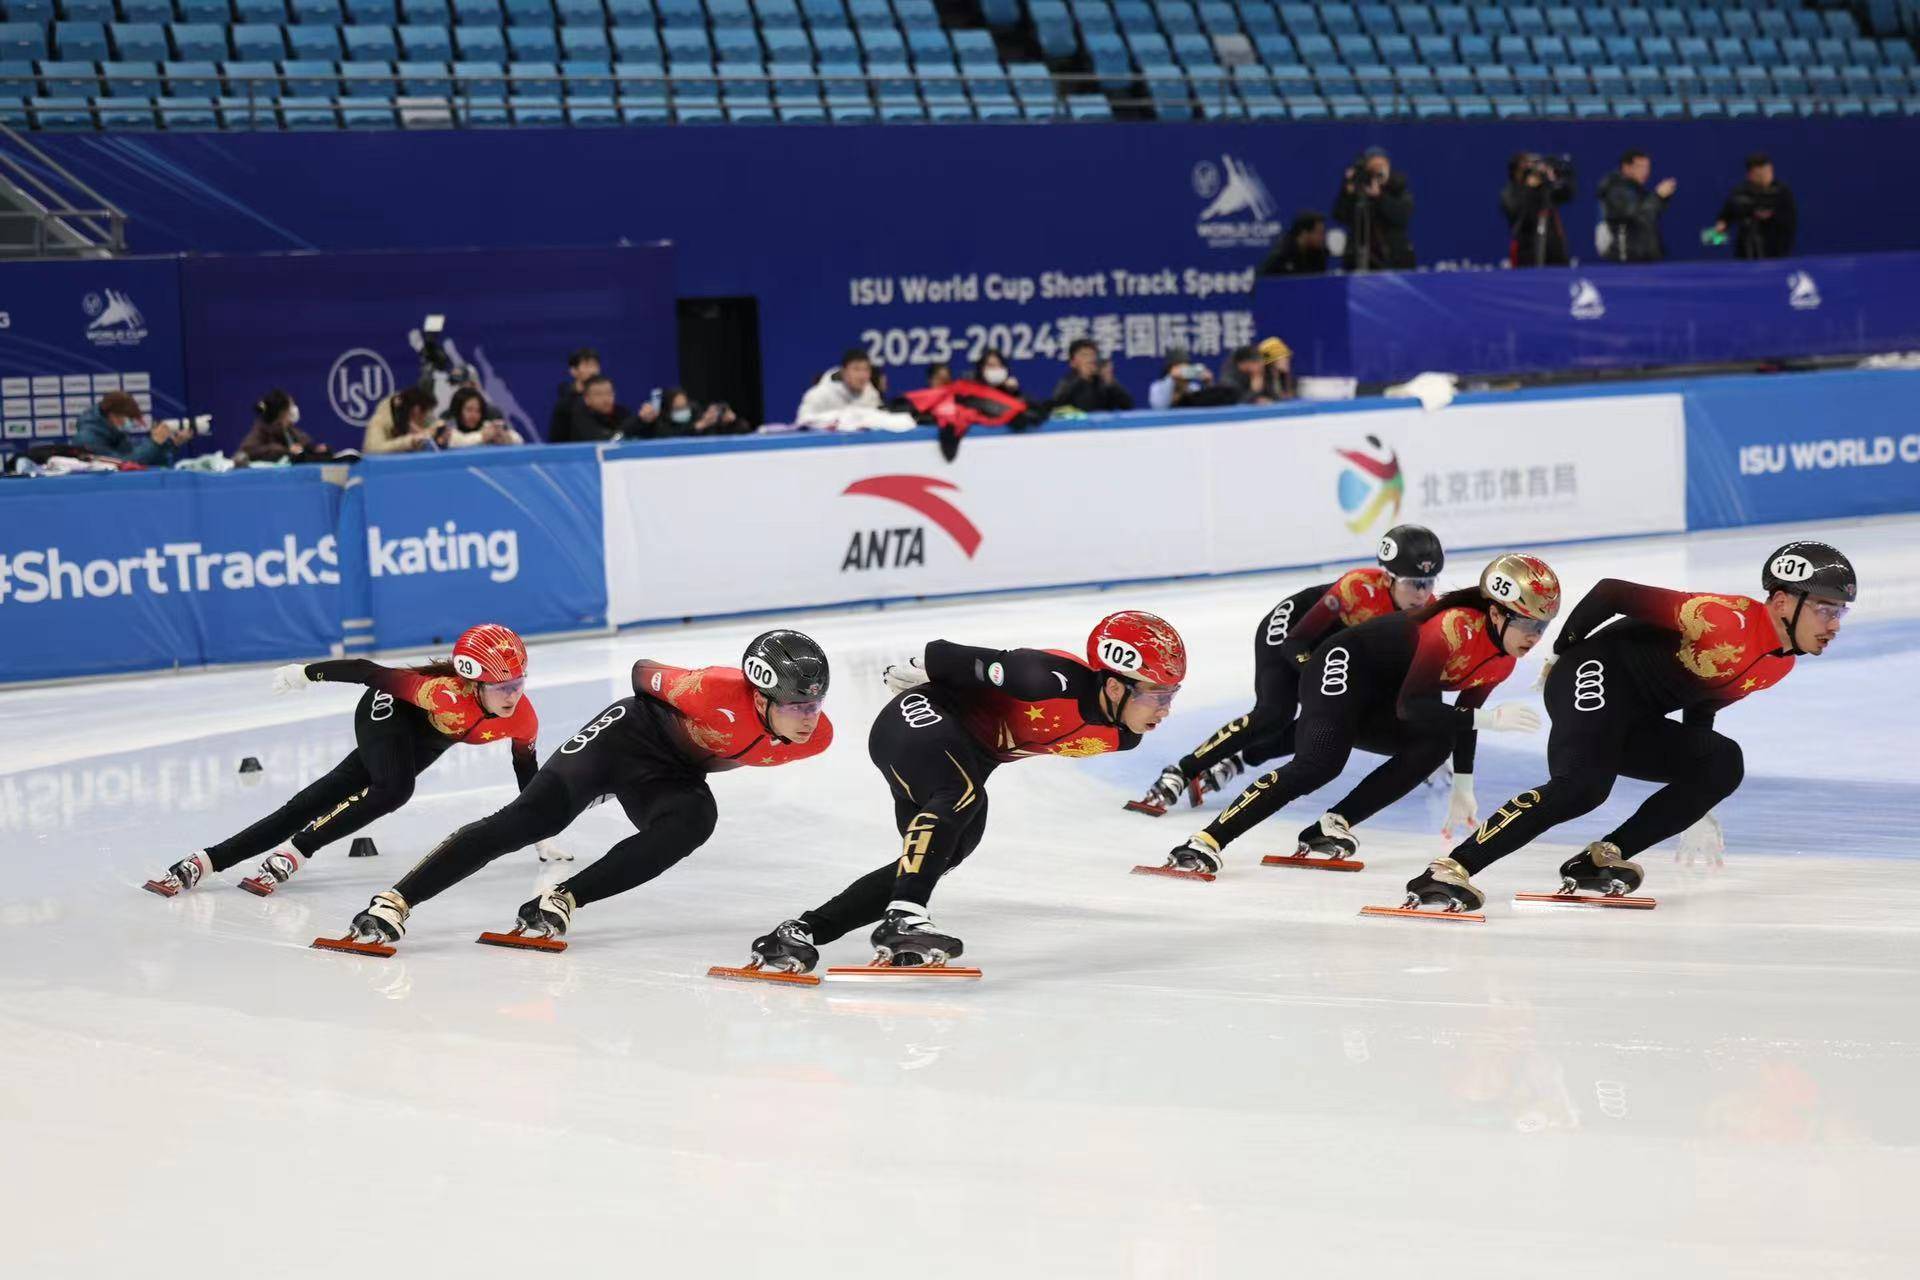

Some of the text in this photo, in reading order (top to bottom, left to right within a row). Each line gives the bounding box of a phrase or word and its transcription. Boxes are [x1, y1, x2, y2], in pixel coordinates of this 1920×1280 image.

[850, 266, 1256, 306] ISU World Cup Short Track Speed
[1739, 433, 1920, 475] ISU WORLD C
[367, 520, 519, 583] kating
[842, 527, 924, 571] ANTA
[1776, 558, 1807, 577] 101
[1492, 576, 1512, 597] 35
[458, 659, 473, 675] 29
[1103, 642, 1136, 668] 102
[748, 660, 772, 685] 100
[896, 812, 939, 878] CHN
